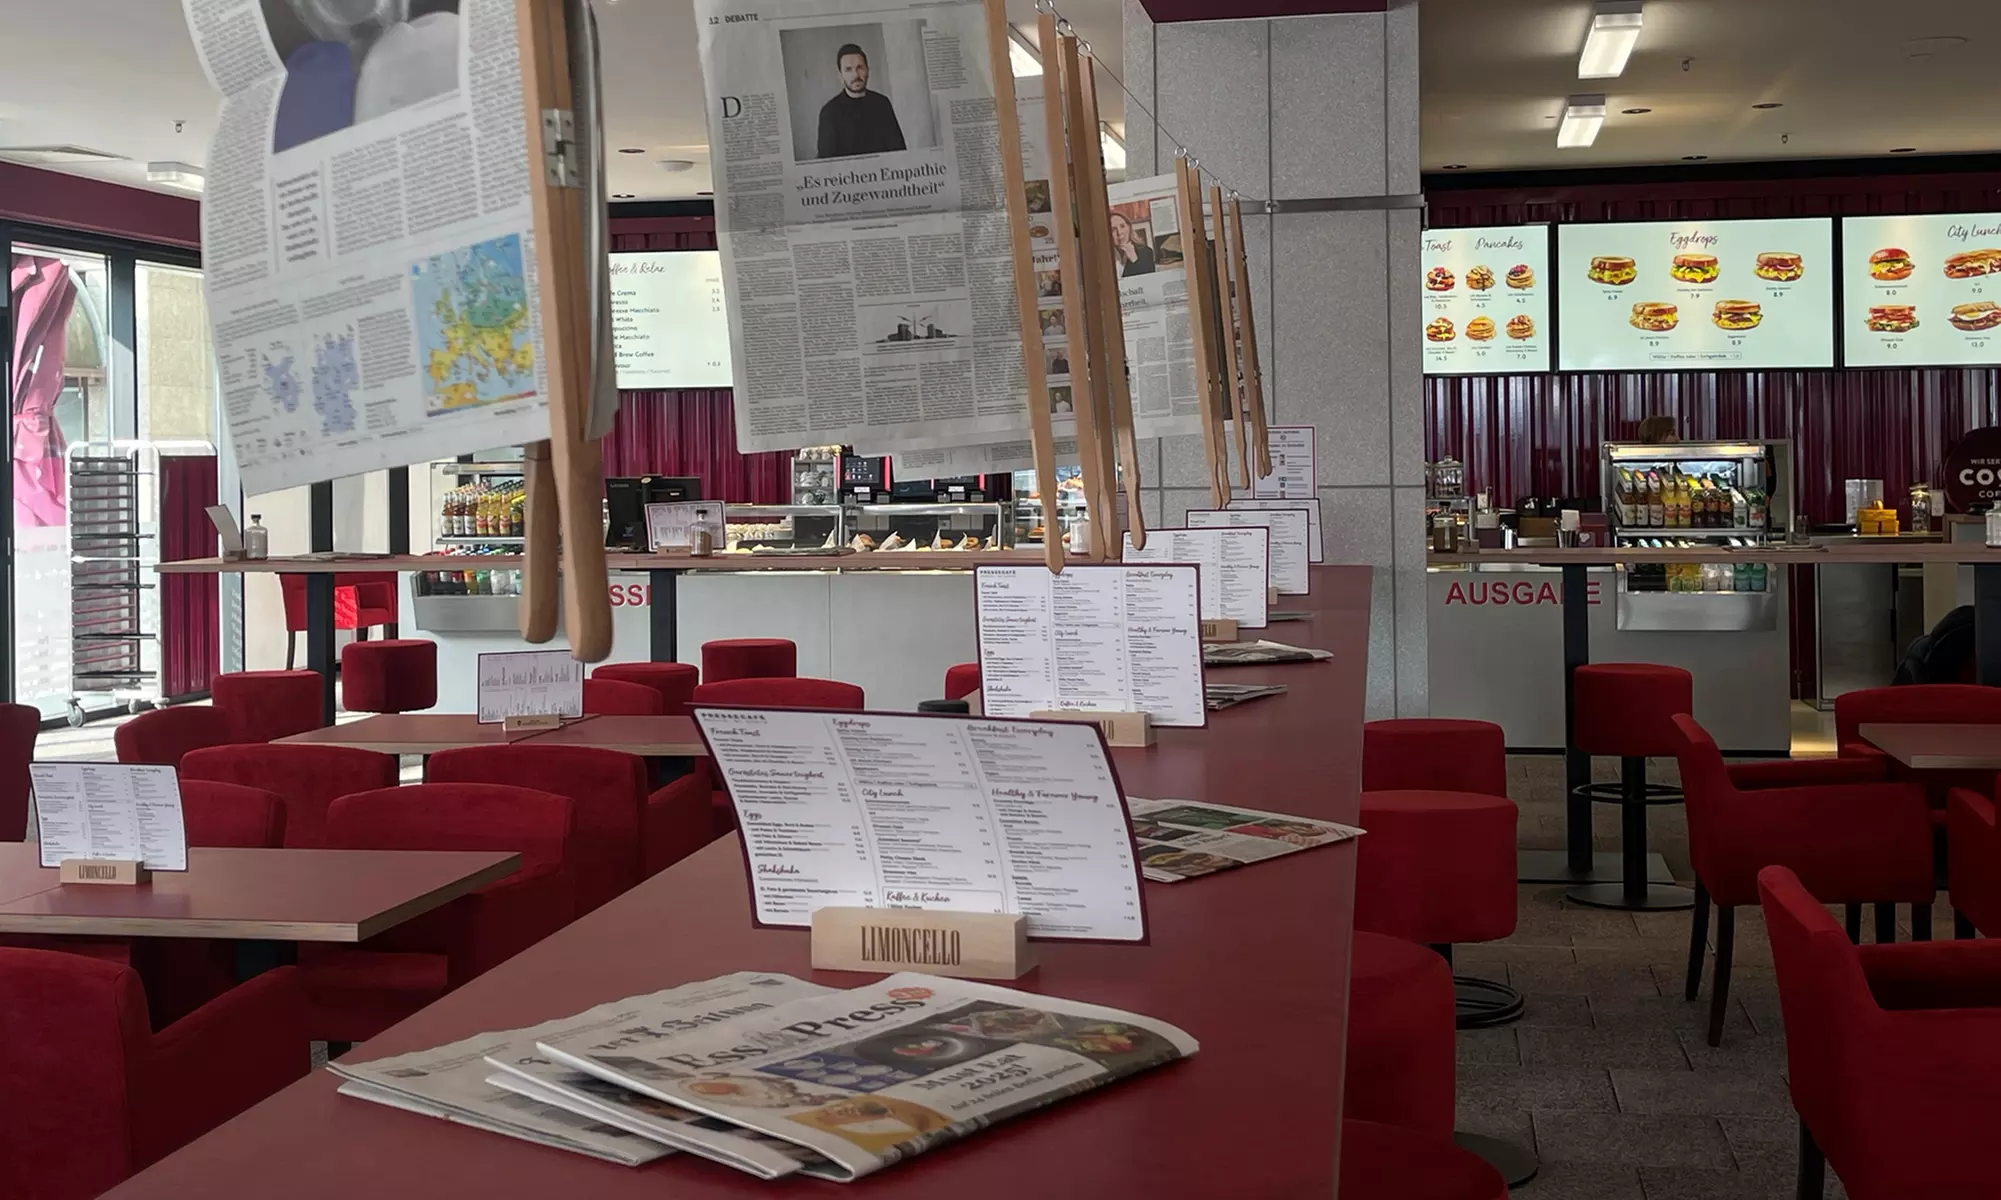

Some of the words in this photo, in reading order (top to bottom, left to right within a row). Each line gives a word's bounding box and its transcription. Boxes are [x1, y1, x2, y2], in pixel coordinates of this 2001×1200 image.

[725, 13, 759, 23] DEBATTE
[824, 171, 878, 188] reichen
[880, 162, 947, 182] Empathie
[801, 193, 829, 207] und
[1669, 230, 1719, 250] Eggdrops
[1947, 224, 1970, 242] City
[1425, 238, 1453, 253] Toast
[1475, 236, 1524, 250] Pancakes
[1970, 457, 1985, 465] WIR
[1445, 581, 1601, 605] AUSGAE
[860, 926, 961, 966] LIMONCELLO
